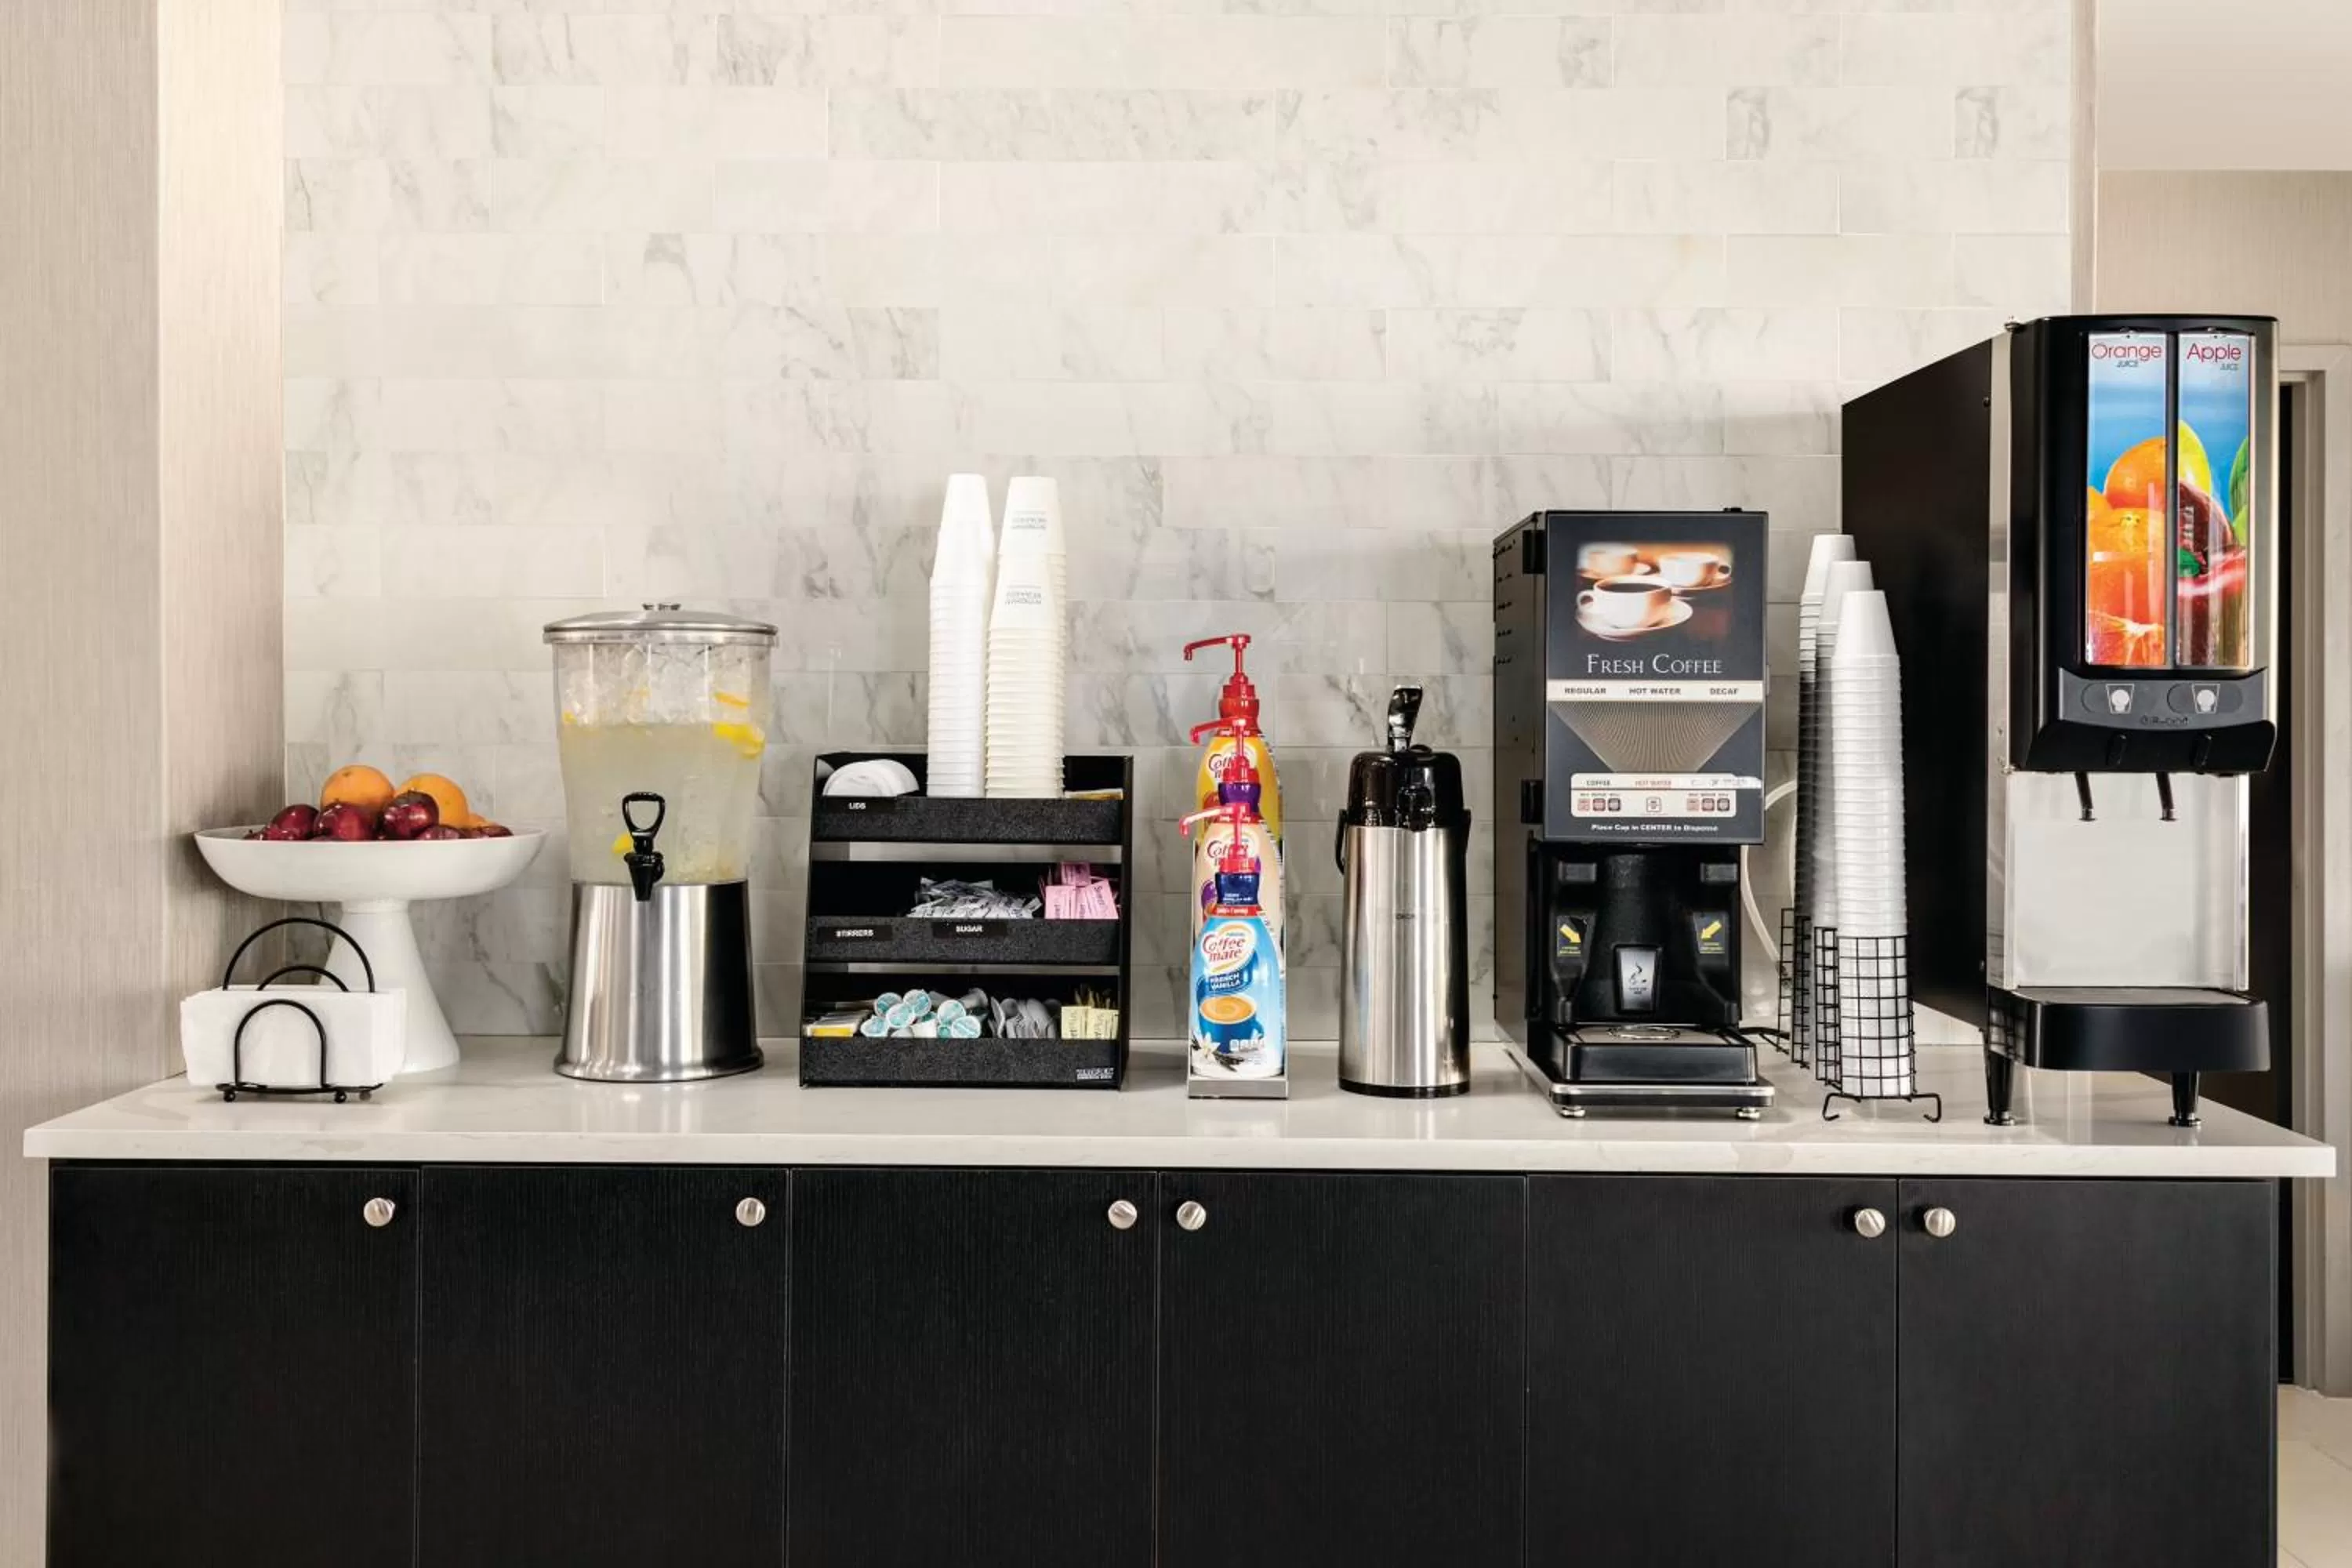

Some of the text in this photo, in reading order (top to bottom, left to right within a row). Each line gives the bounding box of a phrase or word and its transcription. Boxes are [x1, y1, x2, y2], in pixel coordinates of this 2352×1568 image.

[2091, 343, 2162, 361] Orange
[2186, 343, 2241, 363] Apple
[955, 924, 984, 933] SUGAR
[1203, 934, 1246, 954] Coffee
[1209, 948, 1242, 963] mate
